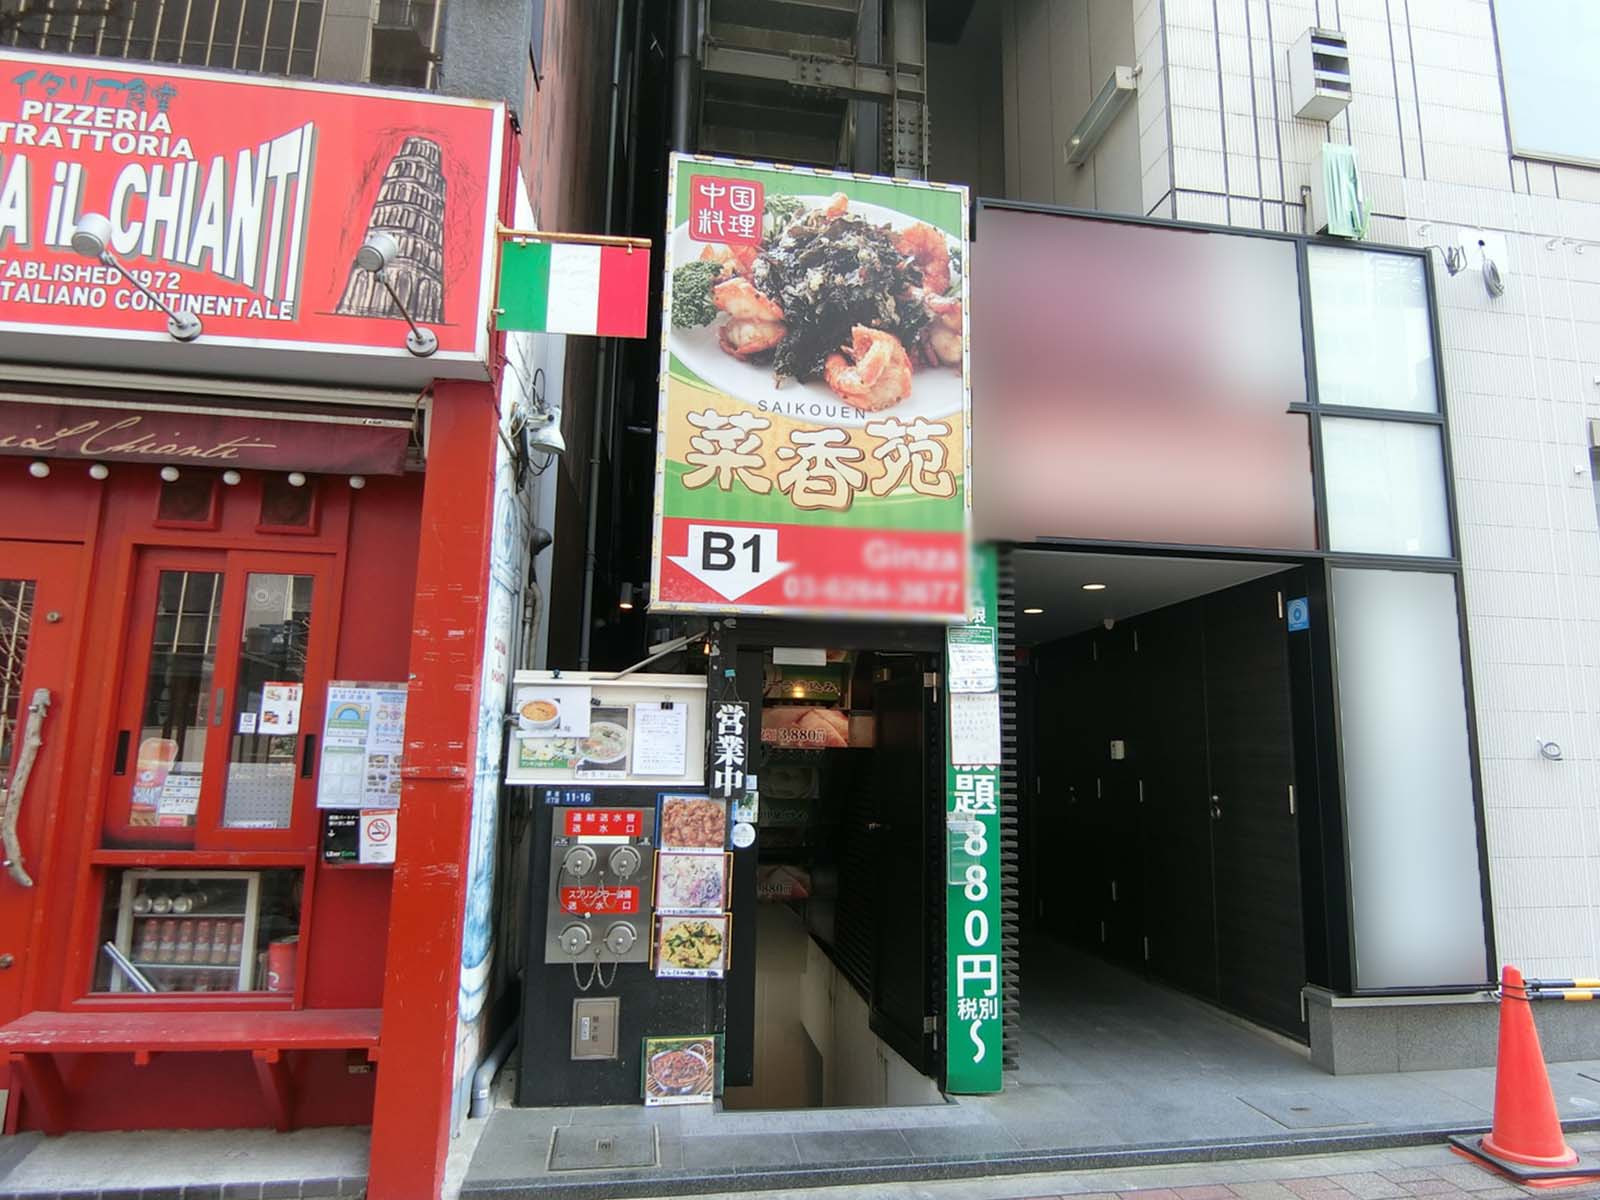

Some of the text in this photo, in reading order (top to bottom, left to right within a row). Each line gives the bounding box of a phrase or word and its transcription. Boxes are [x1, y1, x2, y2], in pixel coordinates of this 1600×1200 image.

[21, 99, 173, 134] PIZZERIA
[0, 121, 195, 160] TRATTORIA
[110, 121, 314, 304] CHIANTI
[699, 181, 756, 212] 中国
[698, 208, 756, 239] 料理
[131, 269, 181, 290] 1972
[115, 289, 295, 321] CONTINENTALE
[757, 400, 867, 420] SAIKOUEN
[681, 407, 957, 512] 菜香苑
[702, 532, 762, 574] B1
[715, 704, 745, 798] 営業中
